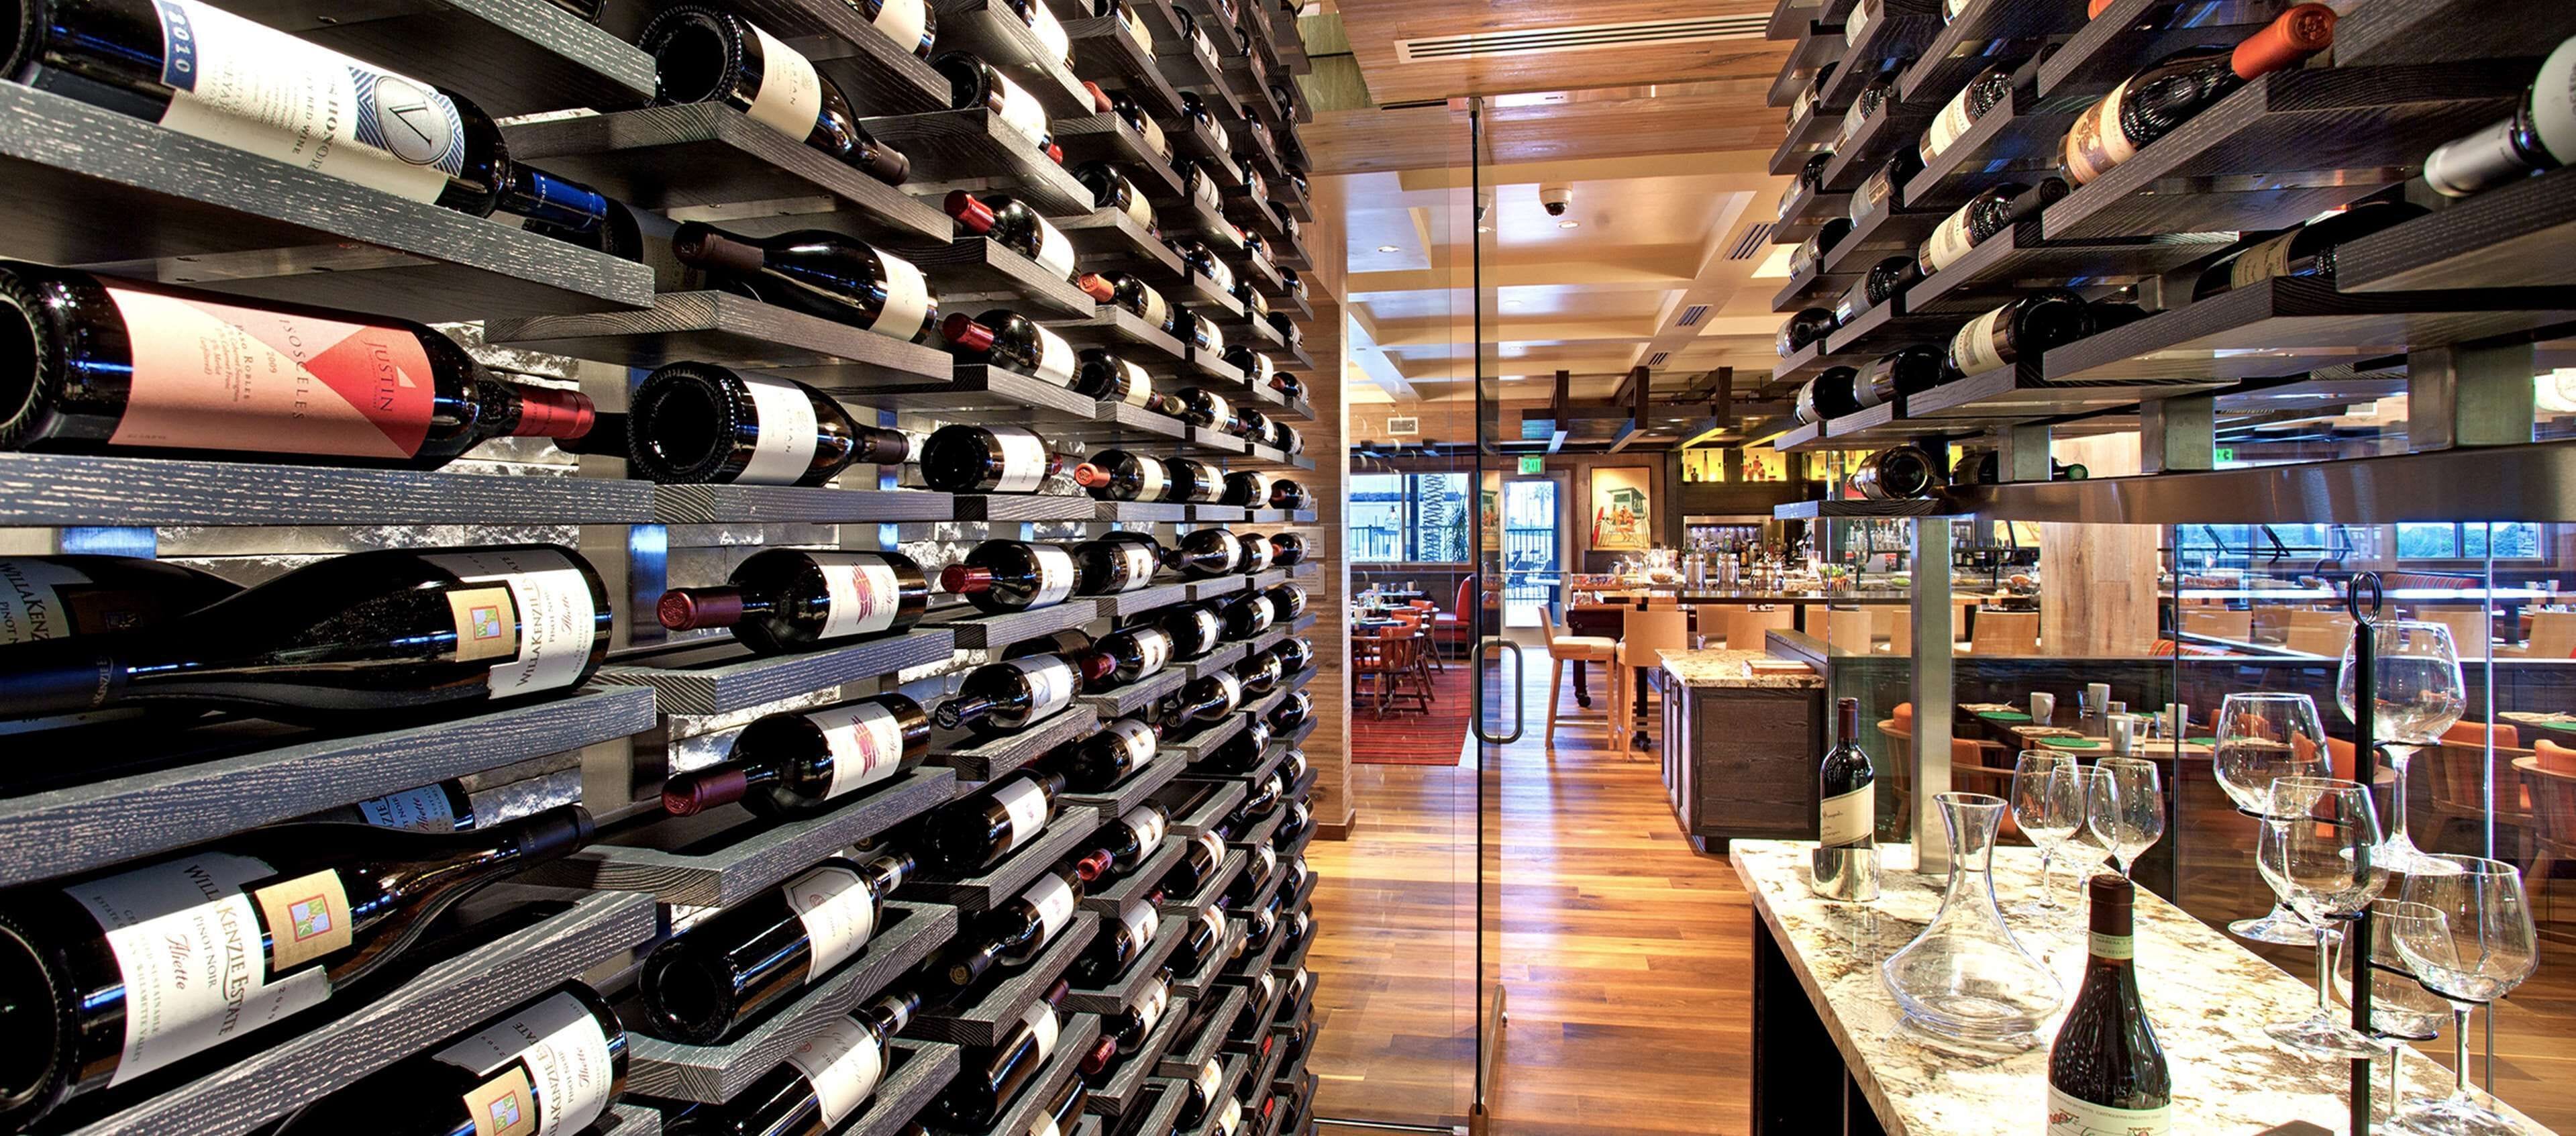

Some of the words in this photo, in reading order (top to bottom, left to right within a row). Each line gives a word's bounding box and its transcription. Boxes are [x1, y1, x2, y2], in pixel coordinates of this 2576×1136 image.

[168, 10, 191, 72] 2010
[389, 100, 433, 150] V
[244, 355, 254, 399] ROBLES
[278, 319, 309, 419] ISOSCELES
[361, 340, 395, 411] JUSTIN
[1523, 458, 1541, 473] EXIT
[0, 562, 50, 641] WILLAKENZ
[166, 934, 191, 990] Aliette
[193, 916, 211, 951] PINOT
[206, 954, 218, 988] NOIR
[218, 973, 249, 1036] ESTATE
